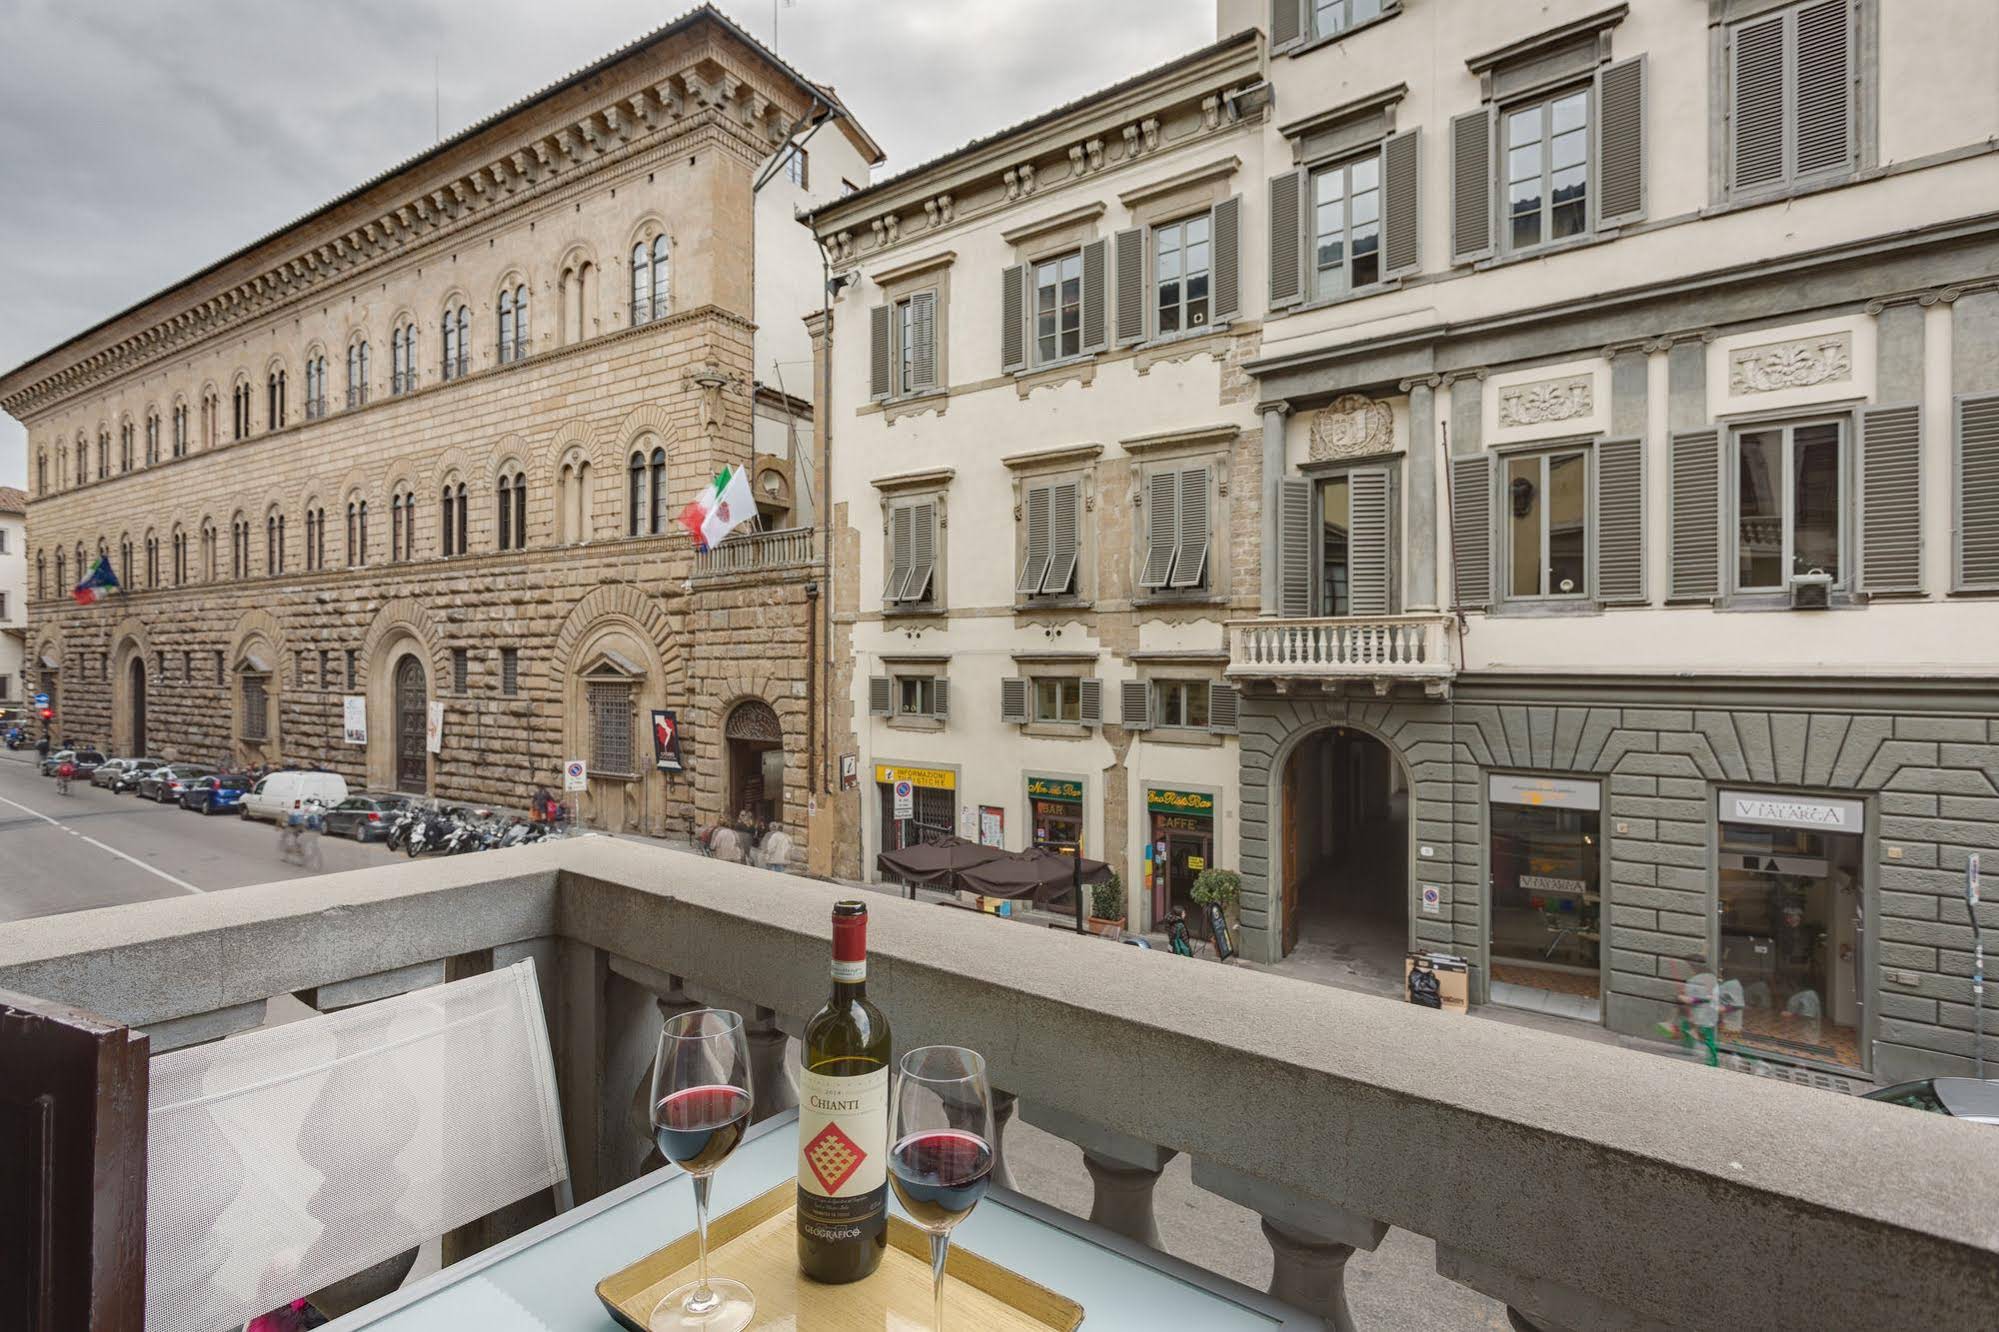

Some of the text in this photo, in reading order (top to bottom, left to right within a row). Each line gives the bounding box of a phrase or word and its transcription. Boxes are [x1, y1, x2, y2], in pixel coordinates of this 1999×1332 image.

[897, 769, 946, 779] INFORMAZIONI
[810, 1095, 859, 1110] CHIANTI
[805, 1223, 862, 1240] GEOGRAFICO
